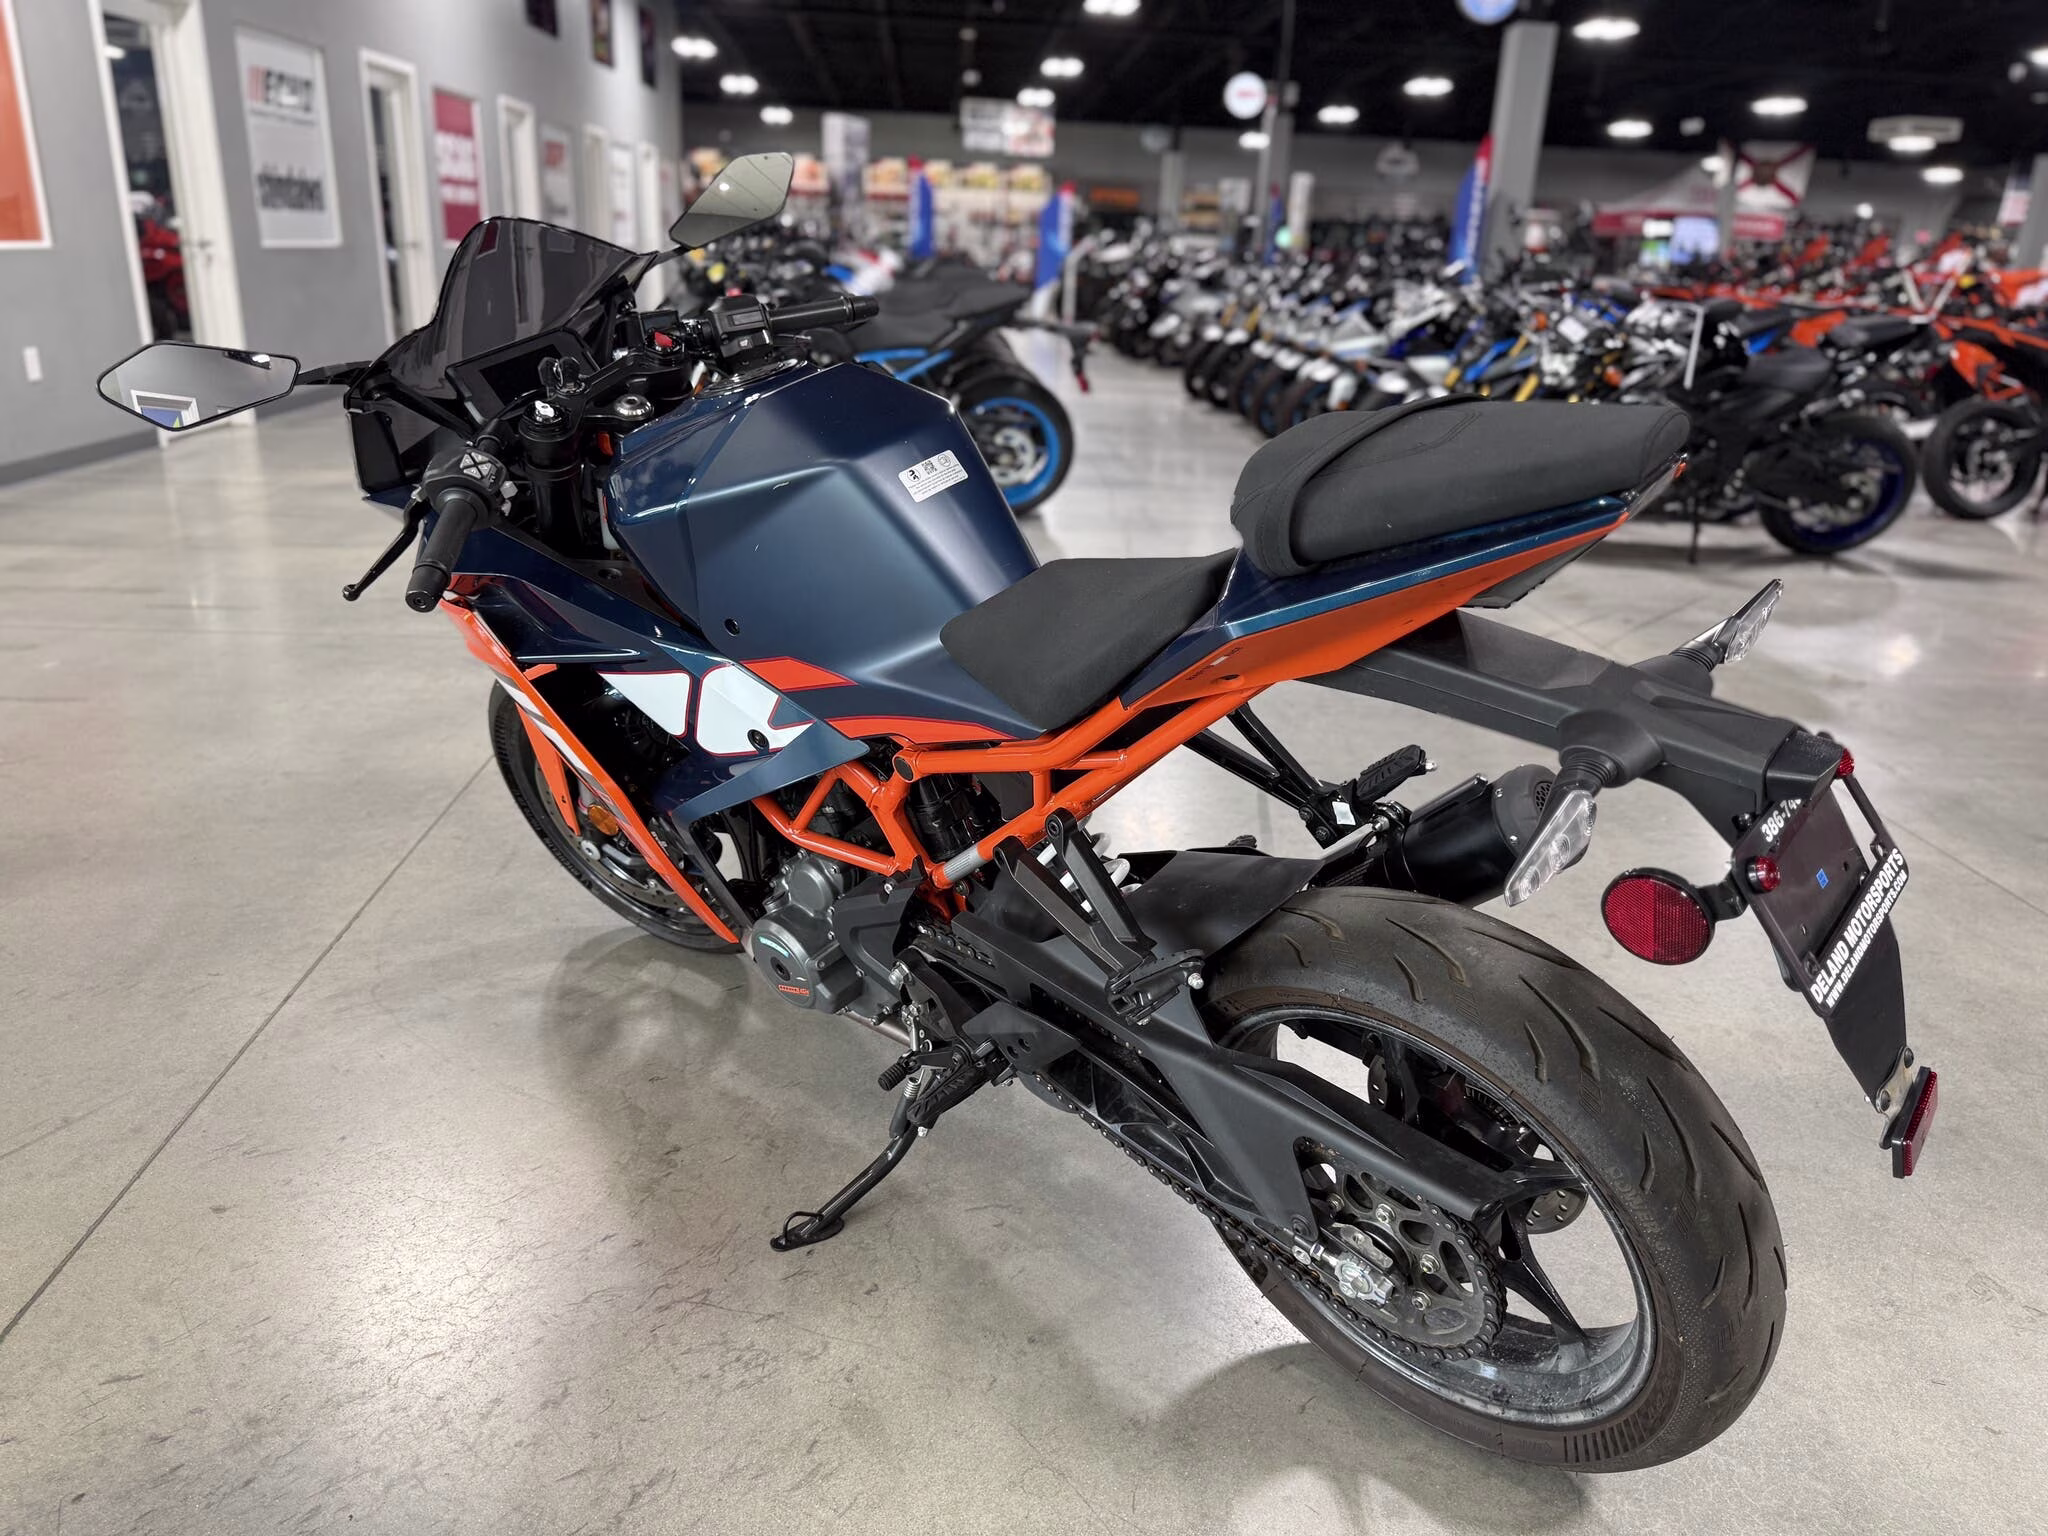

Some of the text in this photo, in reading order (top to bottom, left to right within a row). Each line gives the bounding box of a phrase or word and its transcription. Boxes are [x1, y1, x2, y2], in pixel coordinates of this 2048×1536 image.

[1761, 798, 1801, 842] 386-74
[1810, 848, 1904, 1004] DELAND MOTORSPORTS
[1826, 869, 1907, 1008] WWW.DELANDMOTORSPORTS.COM
